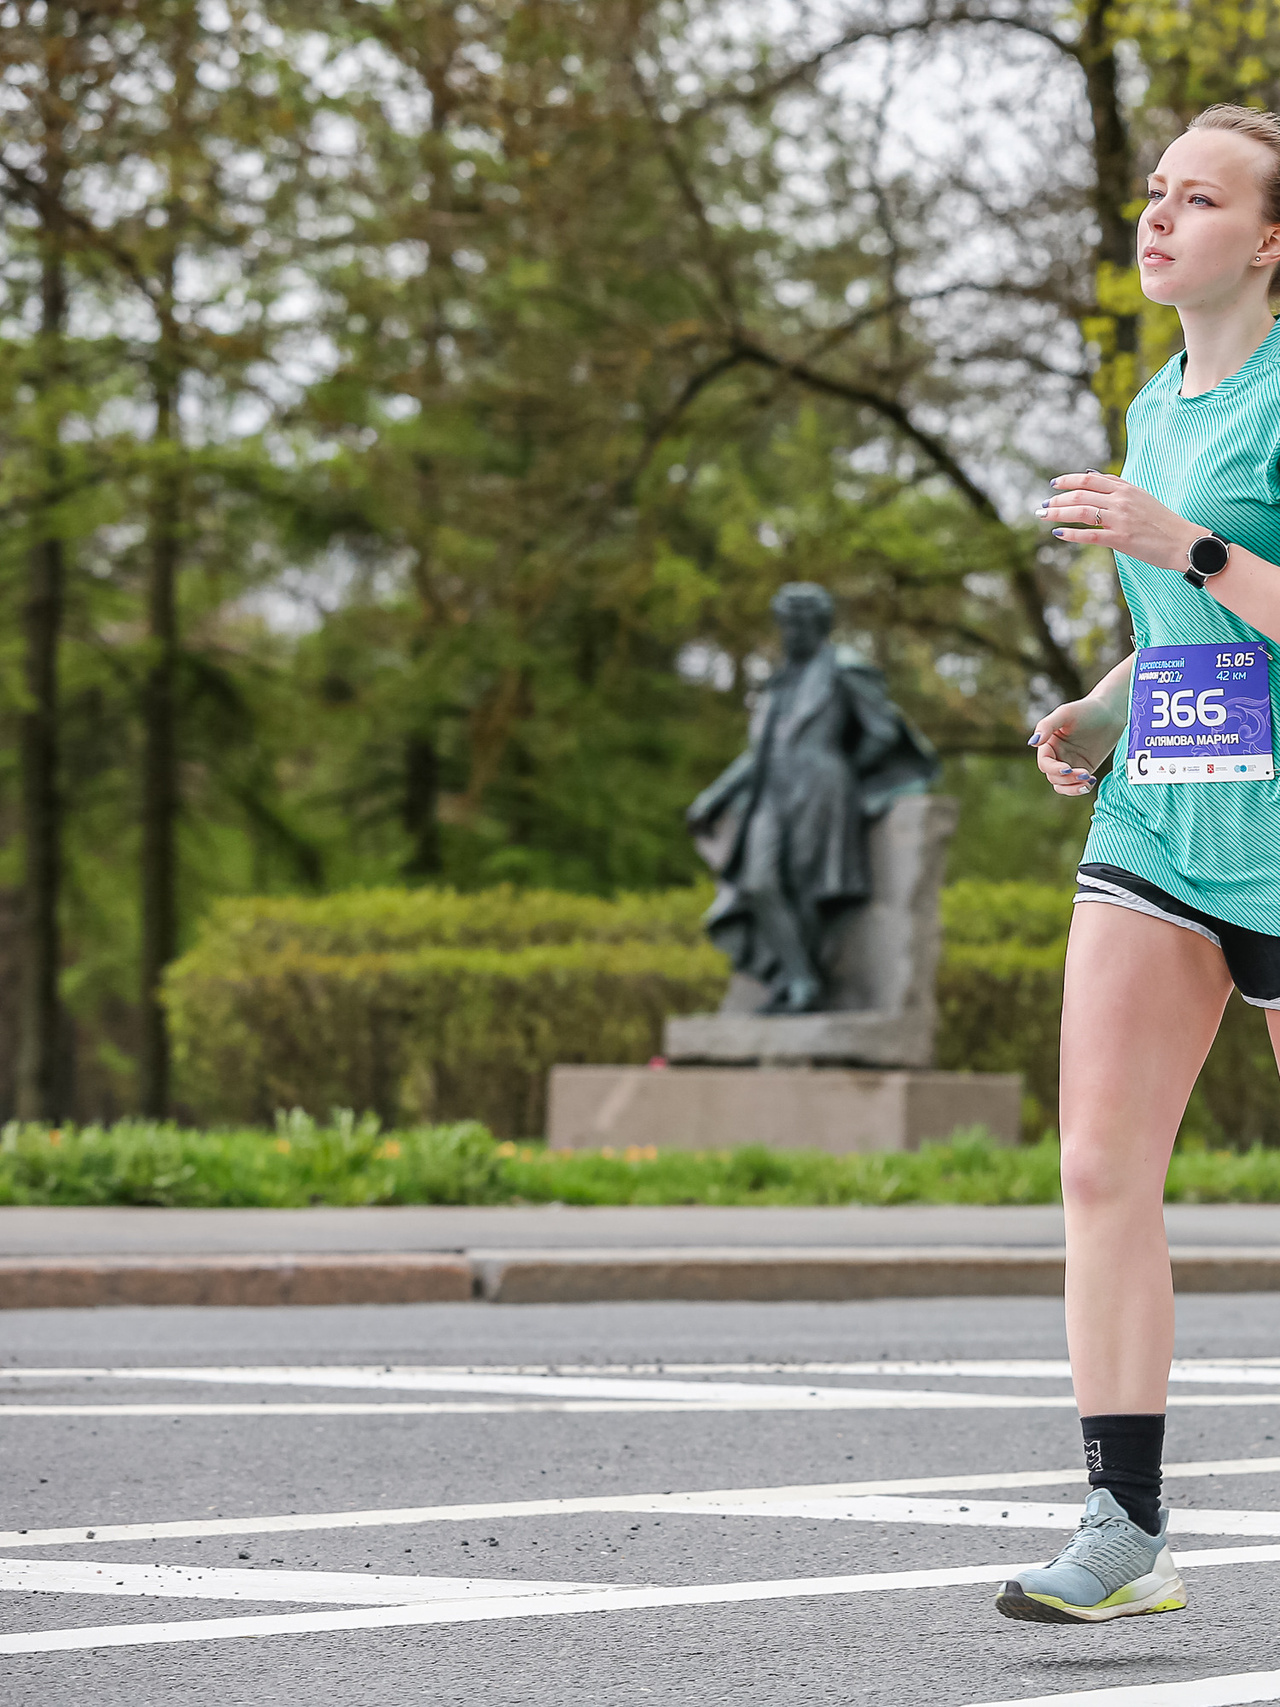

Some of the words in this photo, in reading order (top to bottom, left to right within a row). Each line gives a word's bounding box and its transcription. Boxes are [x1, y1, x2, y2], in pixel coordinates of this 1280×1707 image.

[1215, 653, 1255, 668] 15.05
[1216, 671, 1229, 681] 42
[1151, 688, 1227, 728] 366
[1196, 733, 1239, 745] МАРИЯ
